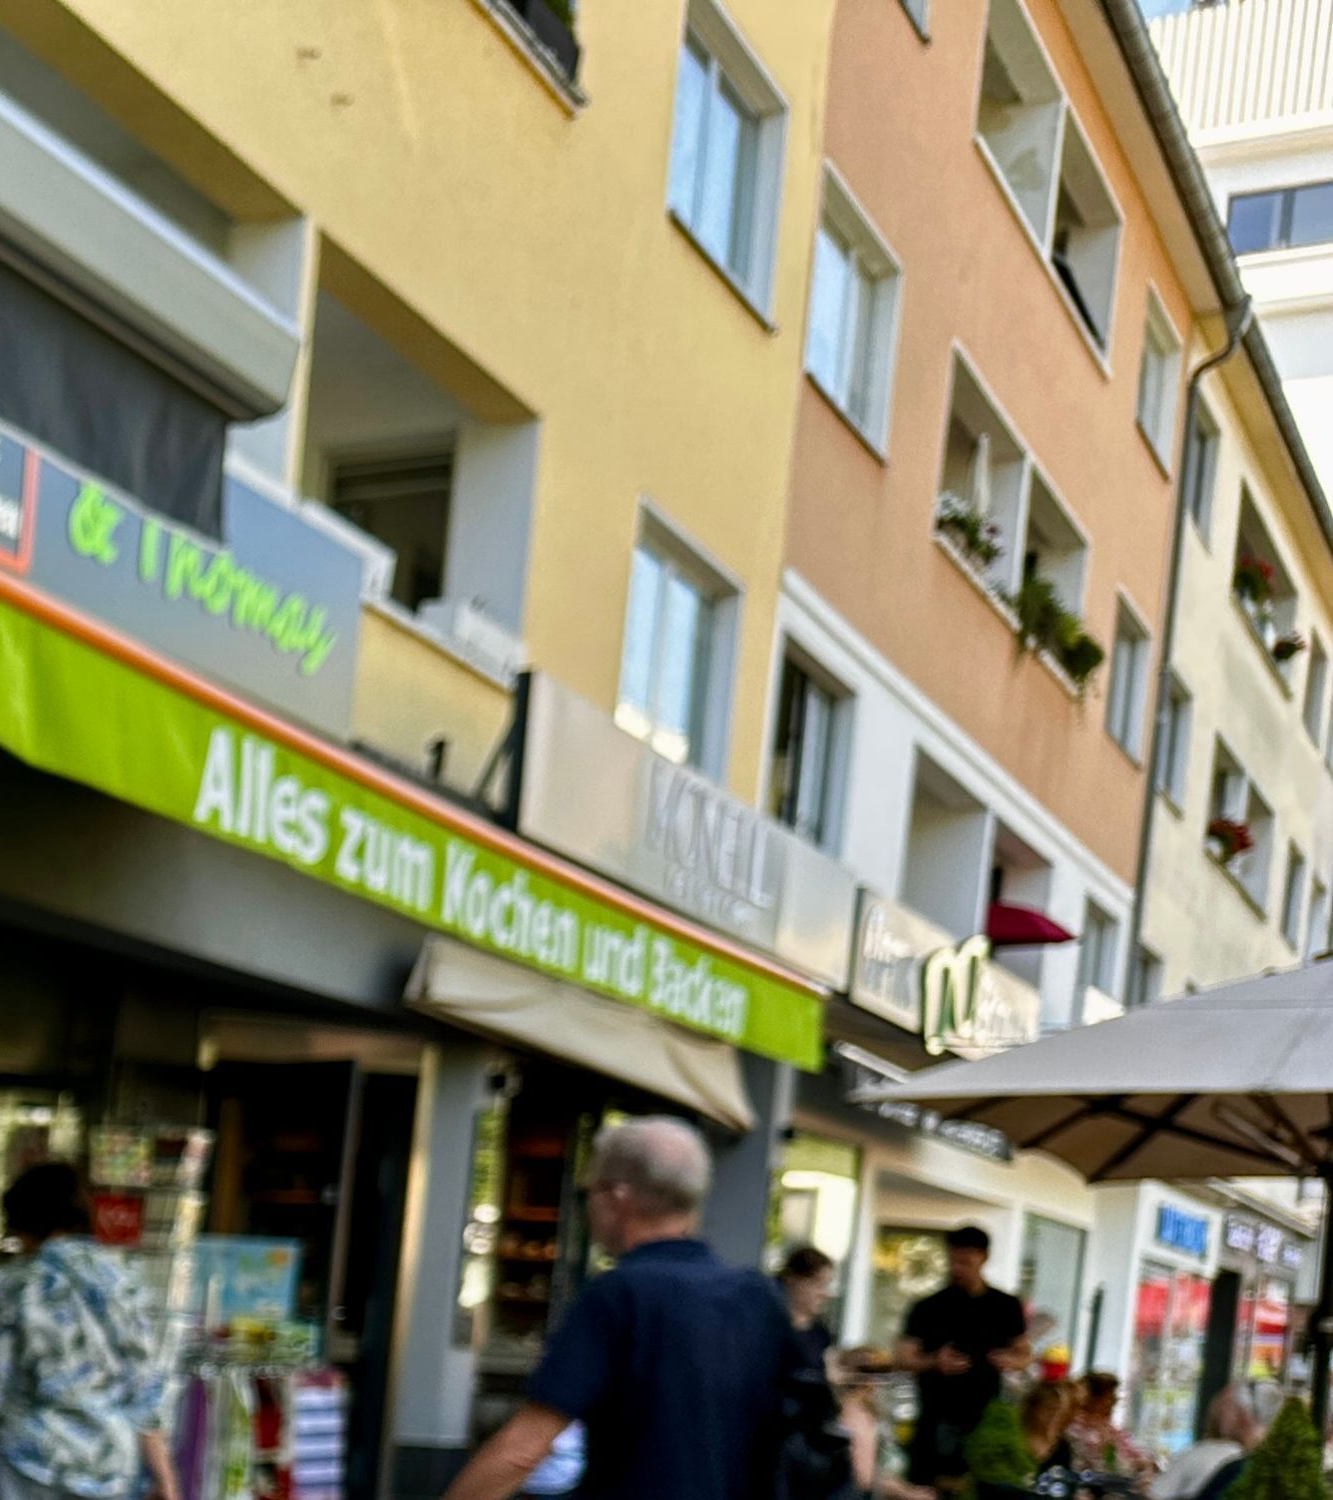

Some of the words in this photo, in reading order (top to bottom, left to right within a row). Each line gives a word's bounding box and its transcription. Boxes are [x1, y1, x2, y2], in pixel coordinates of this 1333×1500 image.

[68, 479, 124, 566] &
[193, 726, 330, 866] Alles
[336, 806, 434, 912] zum
[440, 840, 578, 969] Kochen
[584, 918, 647, 1001] und
